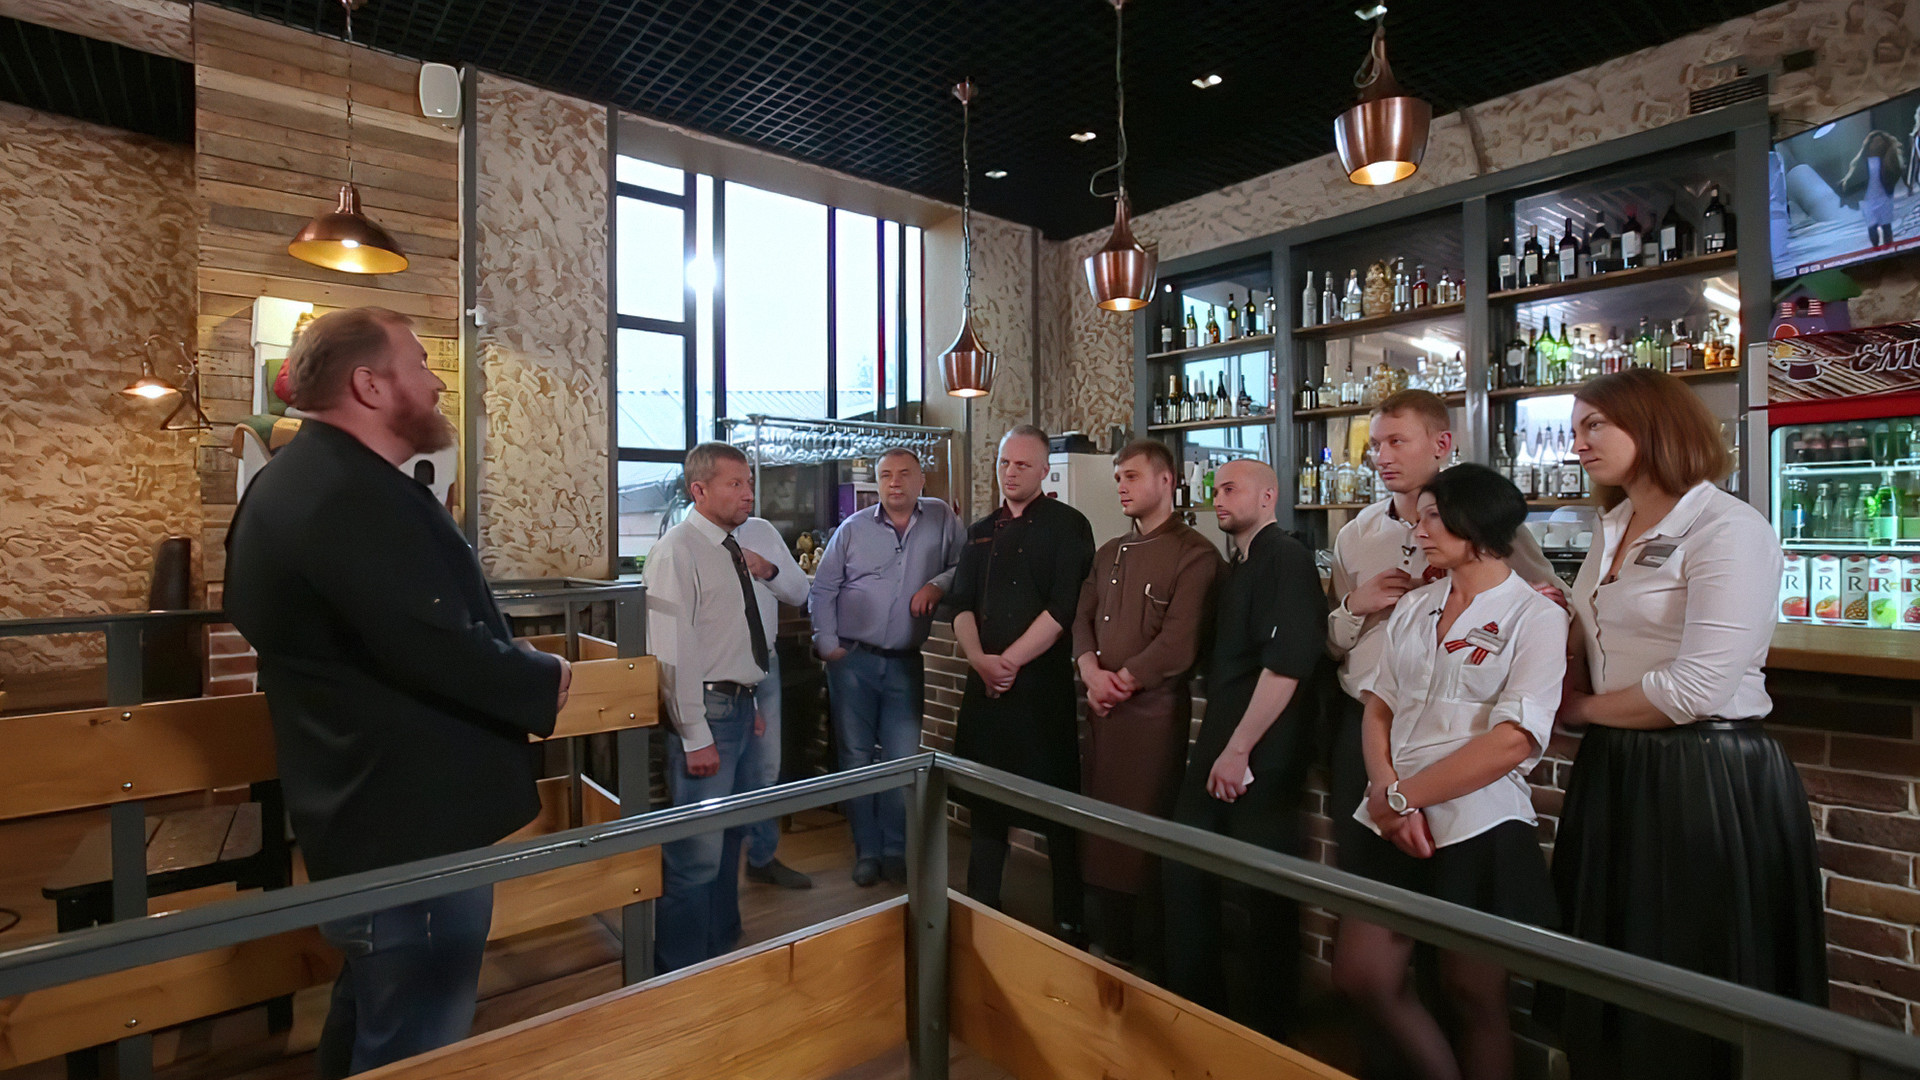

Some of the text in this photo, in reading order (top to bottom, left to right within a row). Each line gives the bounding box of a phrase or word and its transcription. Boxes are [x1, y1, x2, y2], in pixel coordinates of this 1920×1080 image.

[1785, 575, 1799, 590] R
[1819, 575, 1833, 591] R
[1848, 575, 1864, 591] R
